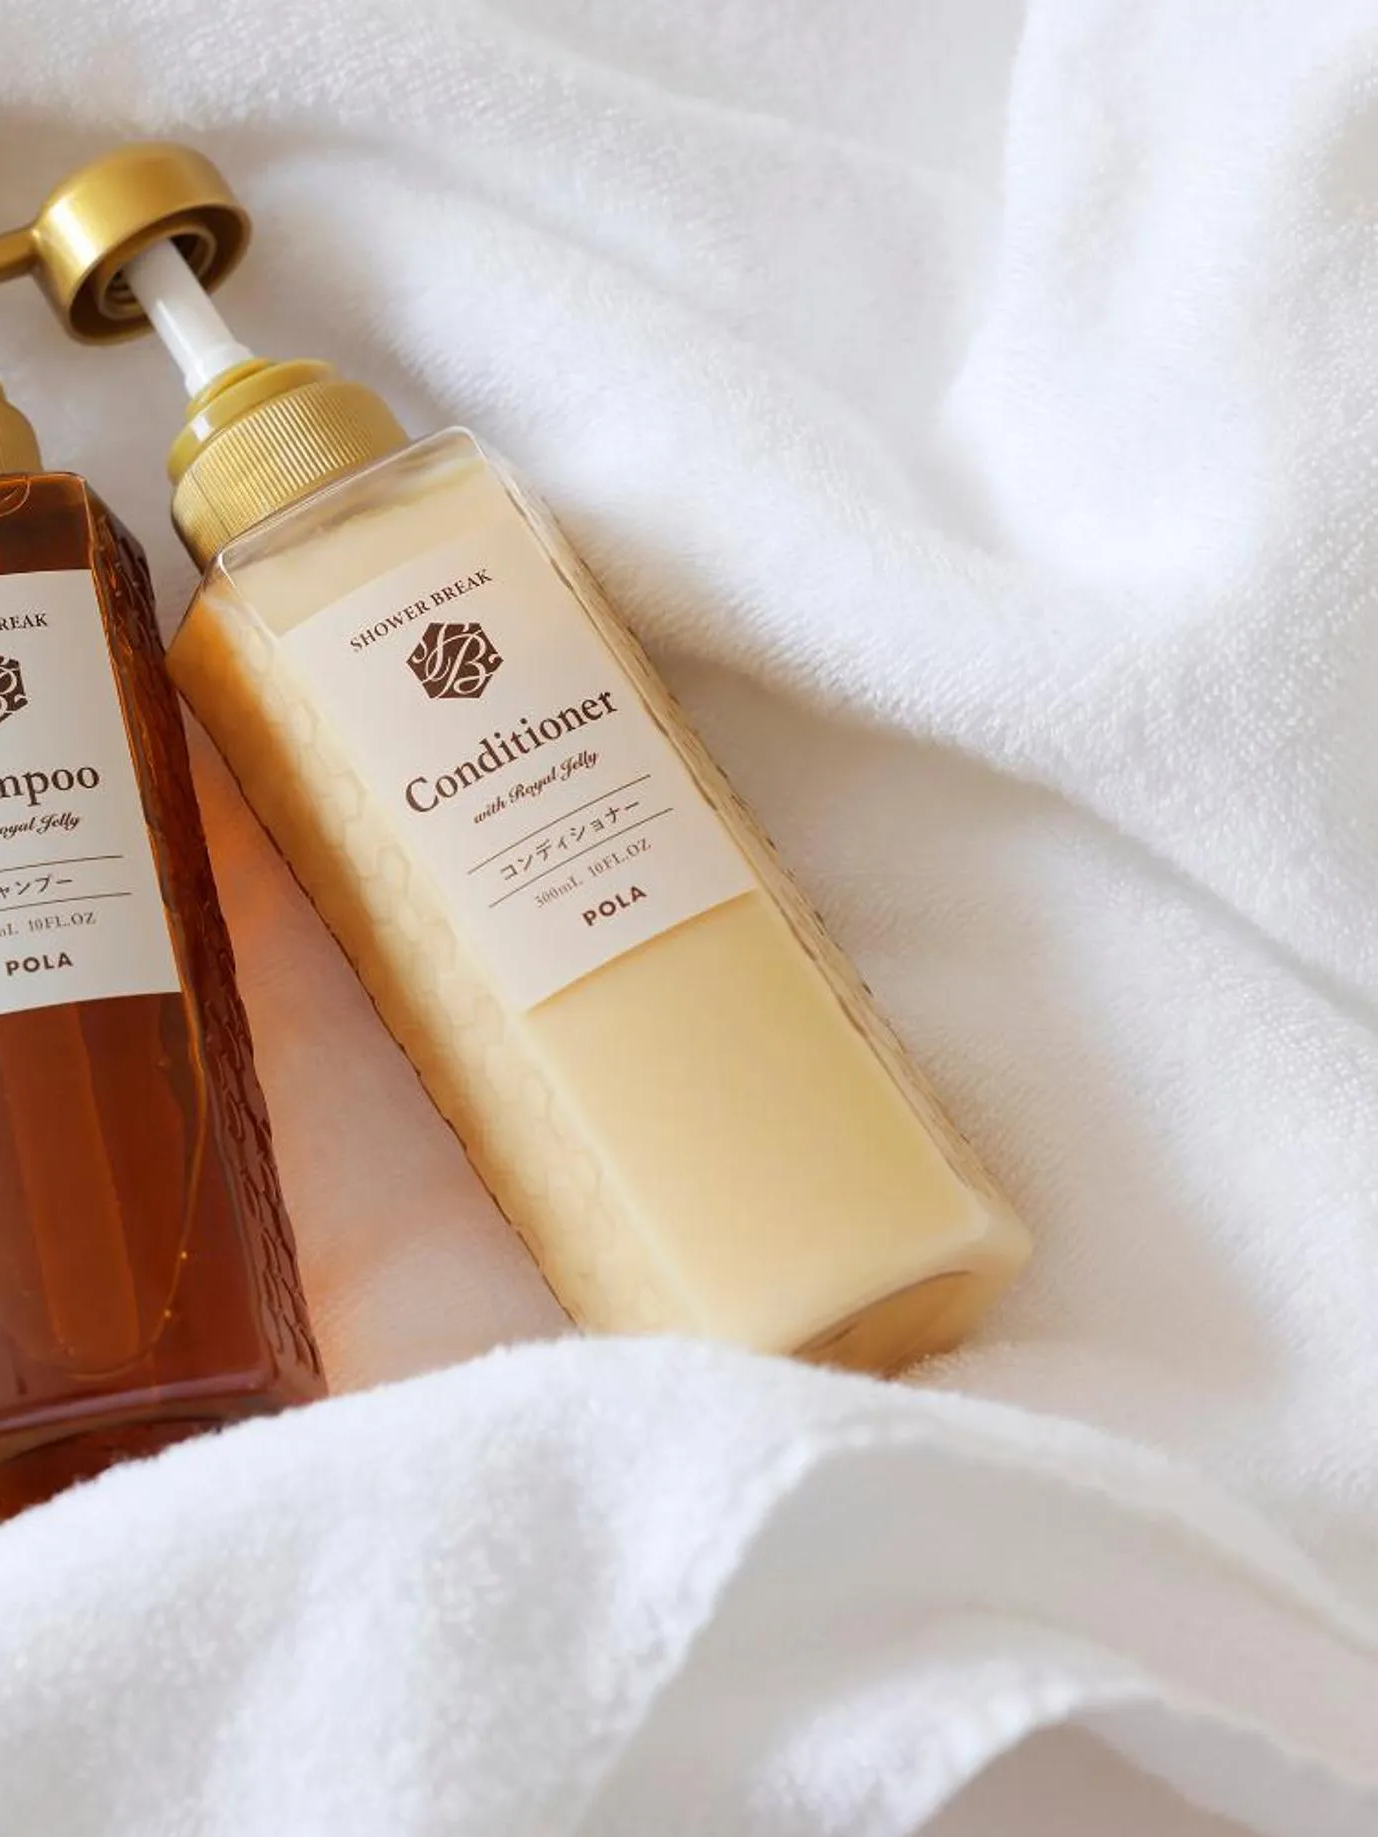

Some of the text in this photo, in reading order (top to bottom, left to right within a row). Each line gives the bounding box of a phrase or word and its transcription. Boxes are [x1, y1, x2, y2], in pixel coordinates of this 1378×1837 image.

[349, 567, 494, 653] SHOWER BREAK
[404, 689, 619, 813] Conditioner
[473, 748, 600, 825] with Royal Jelly
[35, 812, 81, 834] Jelly
[500, 801, 640, 880] コンディショナー
[582, 885, 647, 927] POLA
[5, 952, 73, 976] POLA
